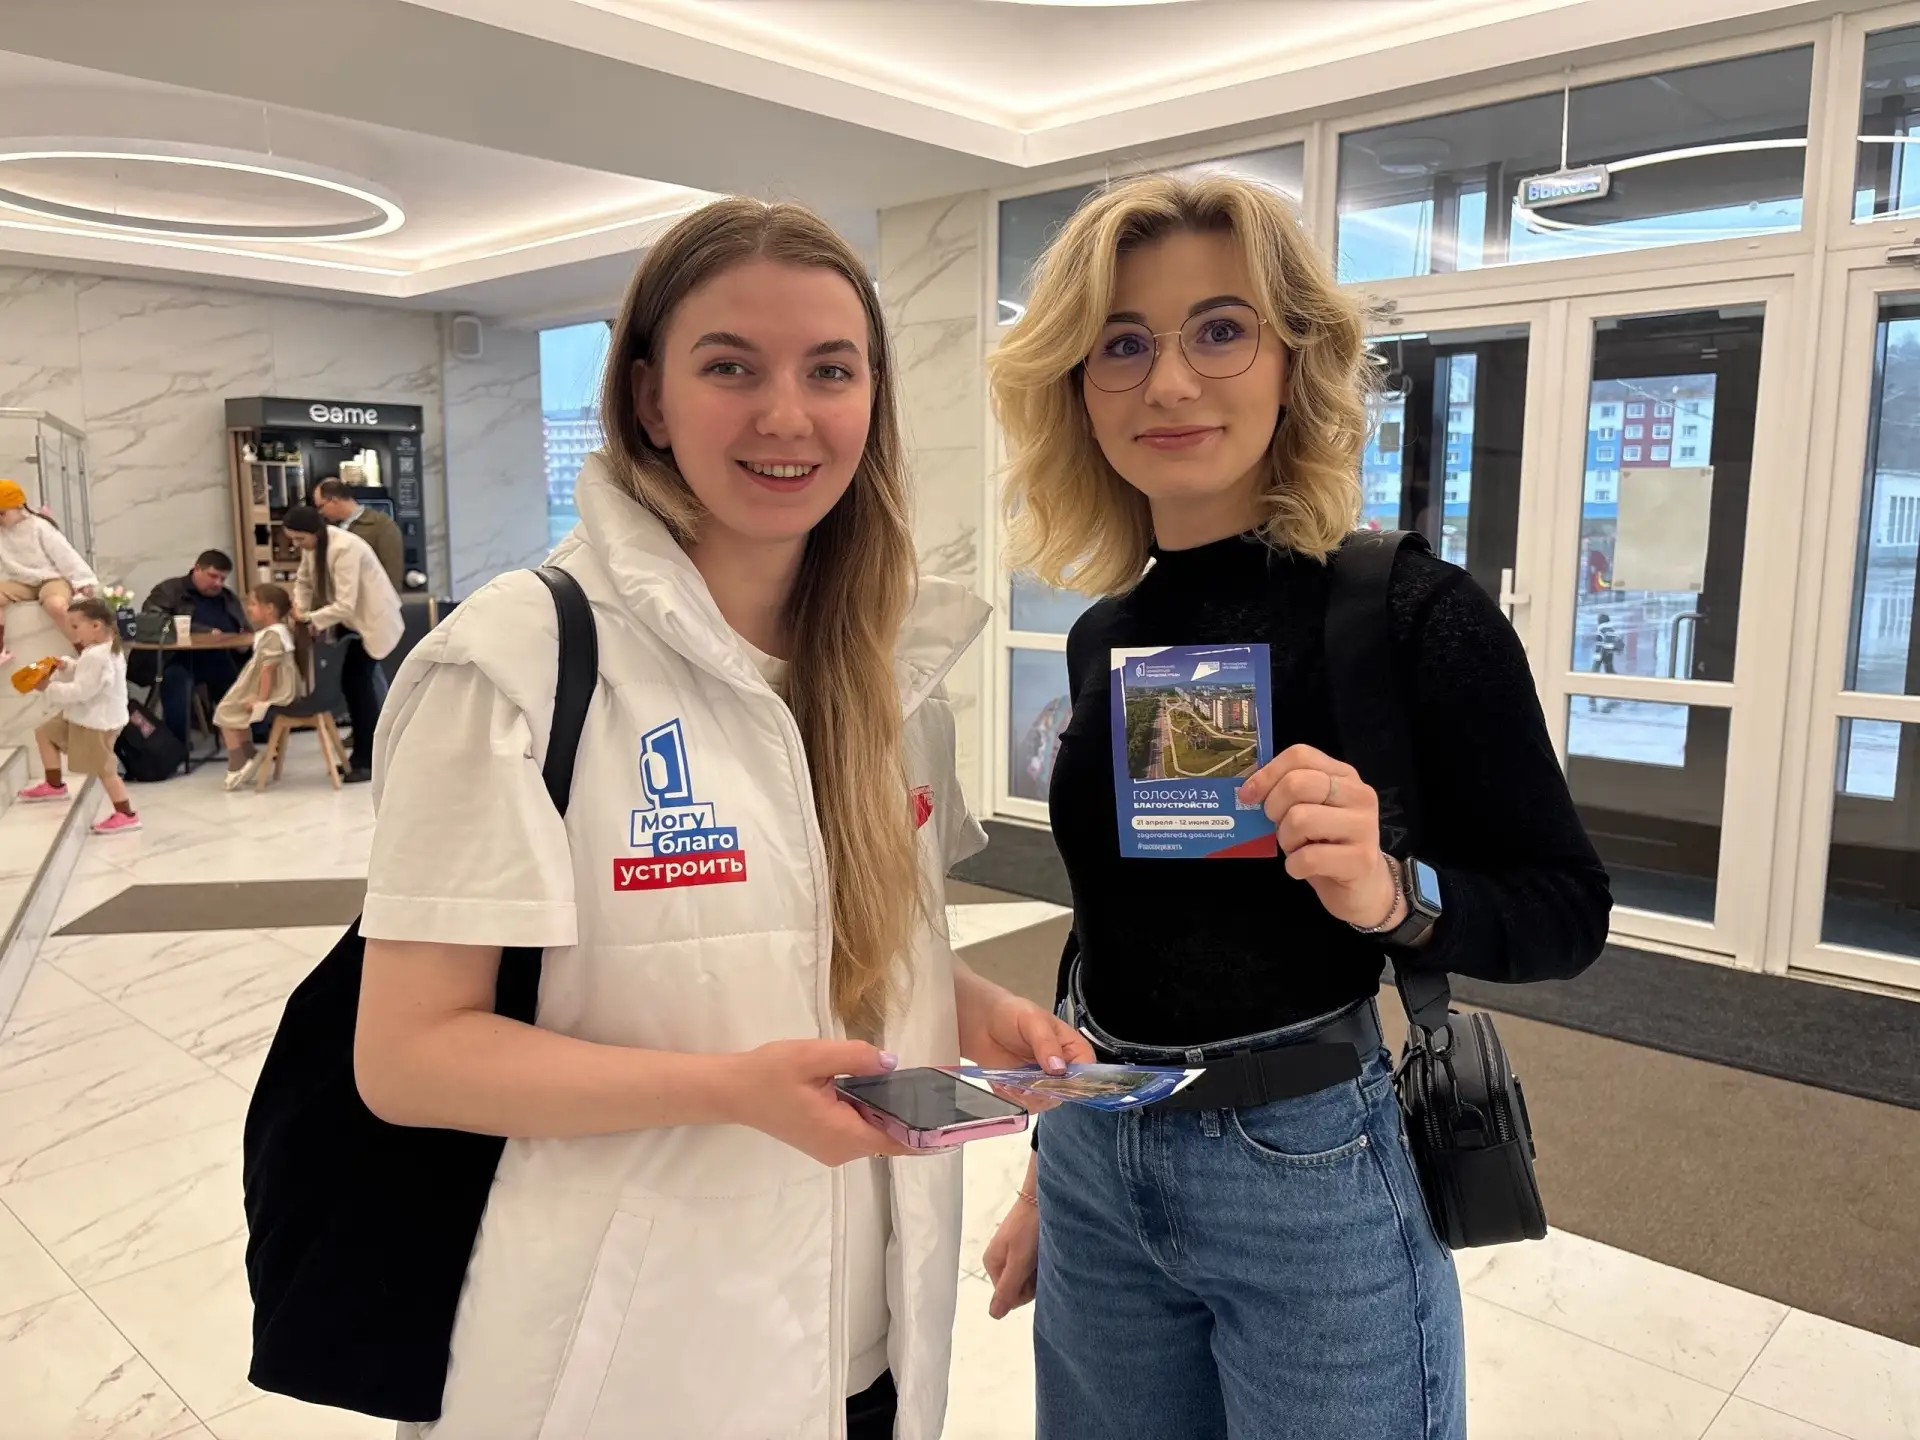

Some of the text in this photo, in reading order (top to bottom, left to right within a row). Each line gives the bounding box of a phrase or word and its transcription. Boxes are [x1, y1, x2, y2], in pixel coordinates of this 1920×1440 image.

[1133, 788, 1219, 800] ГОЛОСУЙ ЗА
[1133, 801, 1219, 809] БЛАГОУСТРОЙСТВО
[641, 811, 706, 833] Могу
[1145, 819, 1173, 827] апреля
[658, 833, 734, 854] благо
[620, 858, 743, 886] устроить
